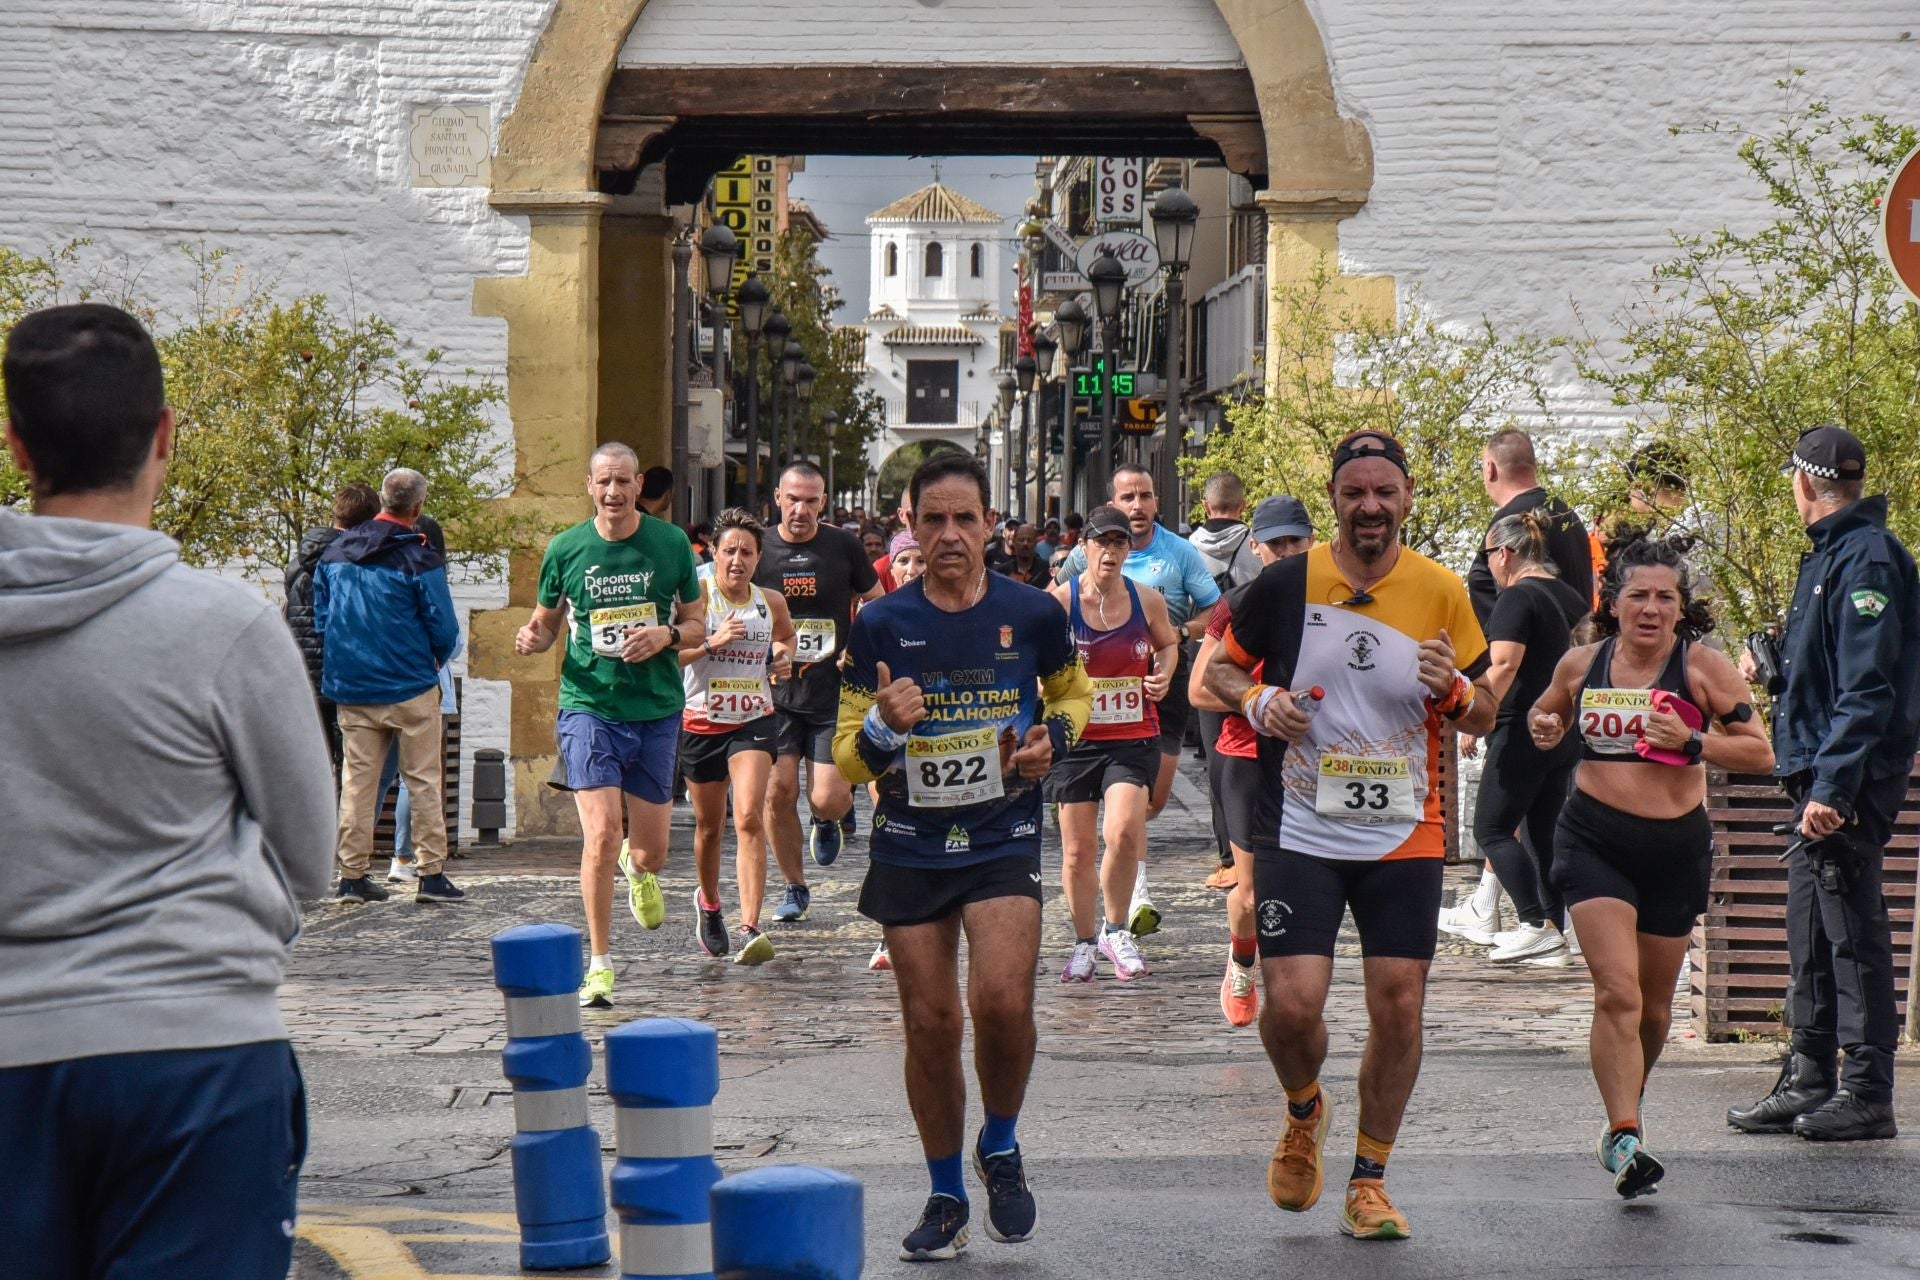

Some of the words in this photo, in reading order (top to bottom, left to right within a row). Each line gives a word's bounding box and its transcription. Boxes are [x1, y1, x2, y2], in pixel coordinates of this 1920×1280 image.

[431, 117, 464, 127] CIUDAD
[424, 146, 472, 156] PROVINCIA
[430, 164, 469, 174] GRANADA
[783, 577, 816, 586] FONDO
[590, 584, 632, 599] DELFOS
[784, 585, 817, 597] 2025
[609, 610, 642, 620] FONDO
[603, 623, 647, 645] 51
[949, 669, 995, 686] CXM
[717, 681, 728, 689] 38
[728, 682, 754, 690] FONDO
[1097, 681, 1129, 689] FONDO
[977, 688, 1021, 704] TRAIL
[1091, 692, 1140, 712] 119
[1594, 692, 1608, 704] 38
[1607, 696, 1652, 706] FONDO
[915, 740, 930, 753] 38
[930, 738, 979, 753] FONDO
[920, 756, 988, 787] 822
[1333, 759, 1350, 773] 38
[1349, 765, 1398, 776] FONDO
[1344, 782, 1389, 810] 33
[945, 840, 970, 848] FAM
